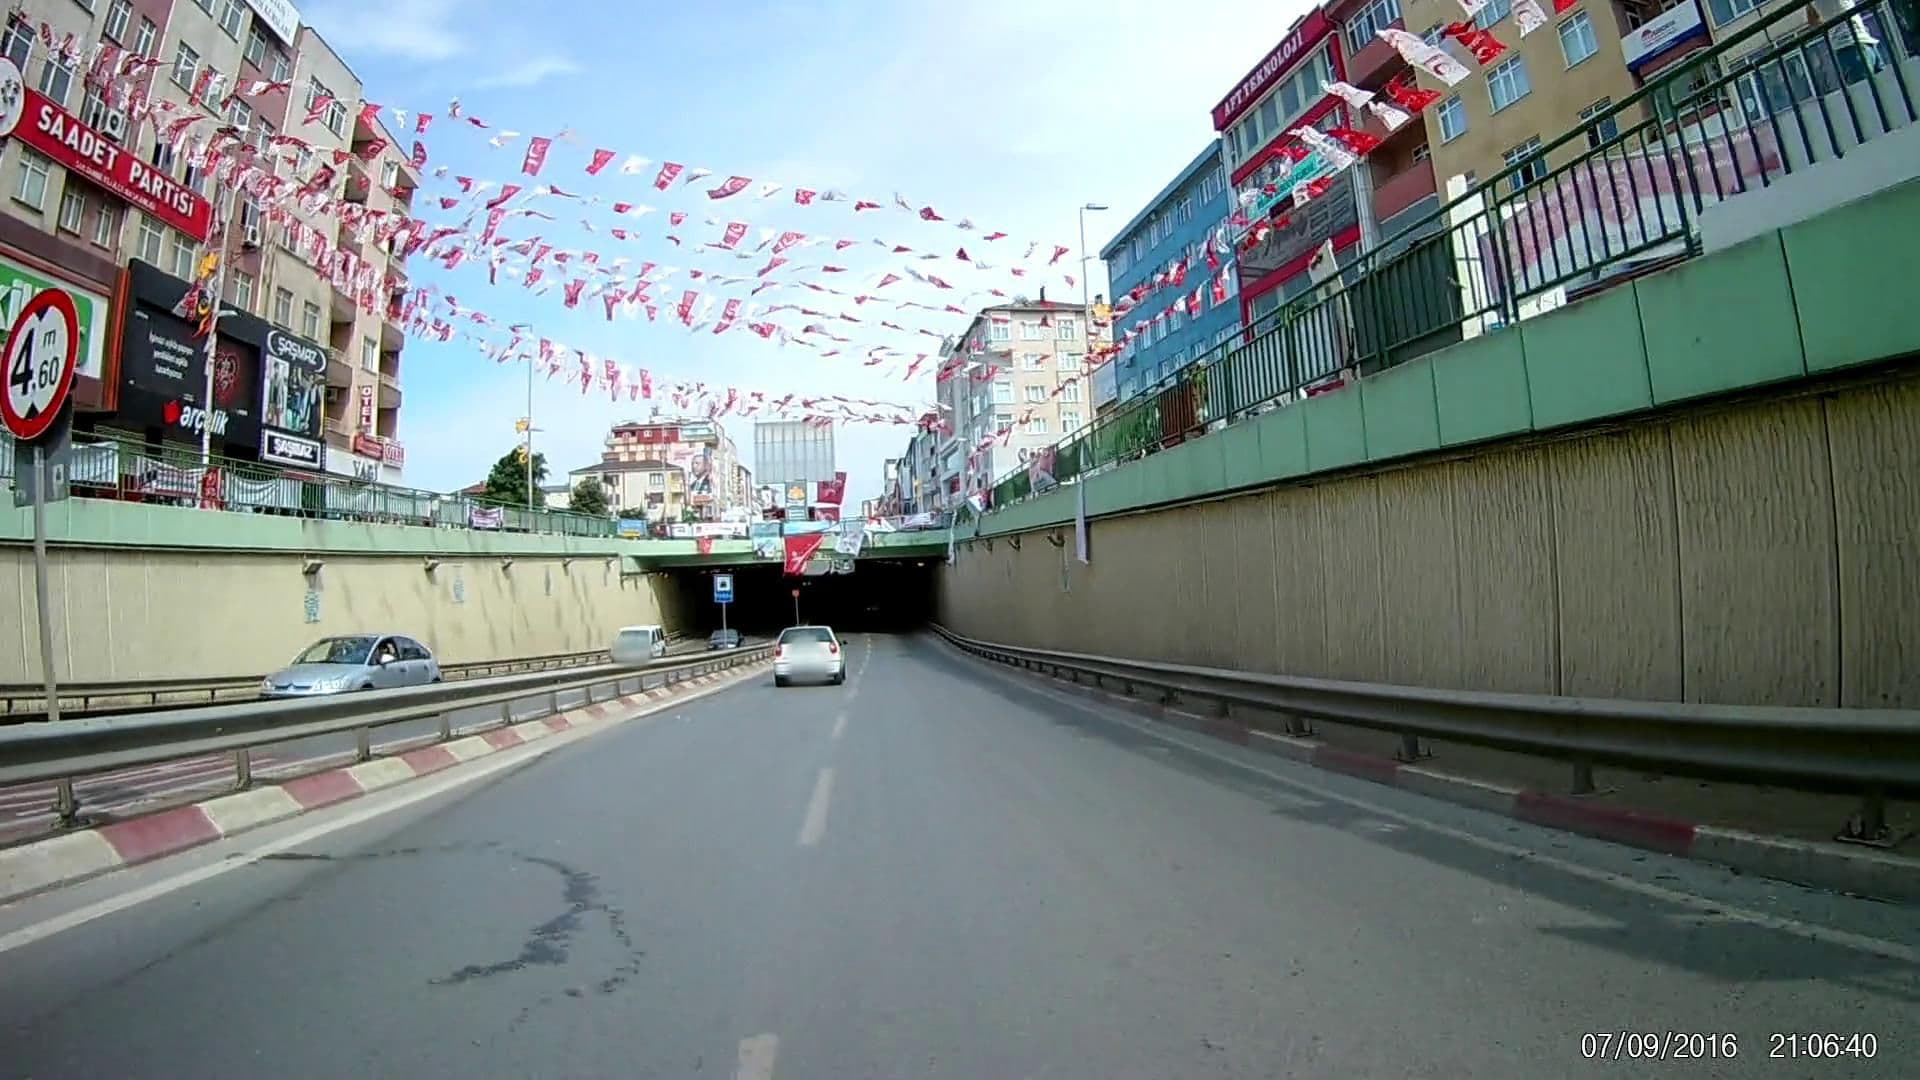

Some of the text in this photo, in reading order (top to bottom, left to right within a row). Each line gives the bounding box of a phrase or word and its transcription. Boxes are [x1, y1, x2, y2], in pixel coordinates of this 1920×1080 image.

[1242, 28, 1304, 97] TEKNOLOJİ
[37, 103, 119, 171] SAADET
[129, 160, 195, 217] PARTİSİ
[42, 329, 56, 347] m
[277, 336, 317, 365] ŞAŞMAZ
[361, 386, 372, 425] OTEL
